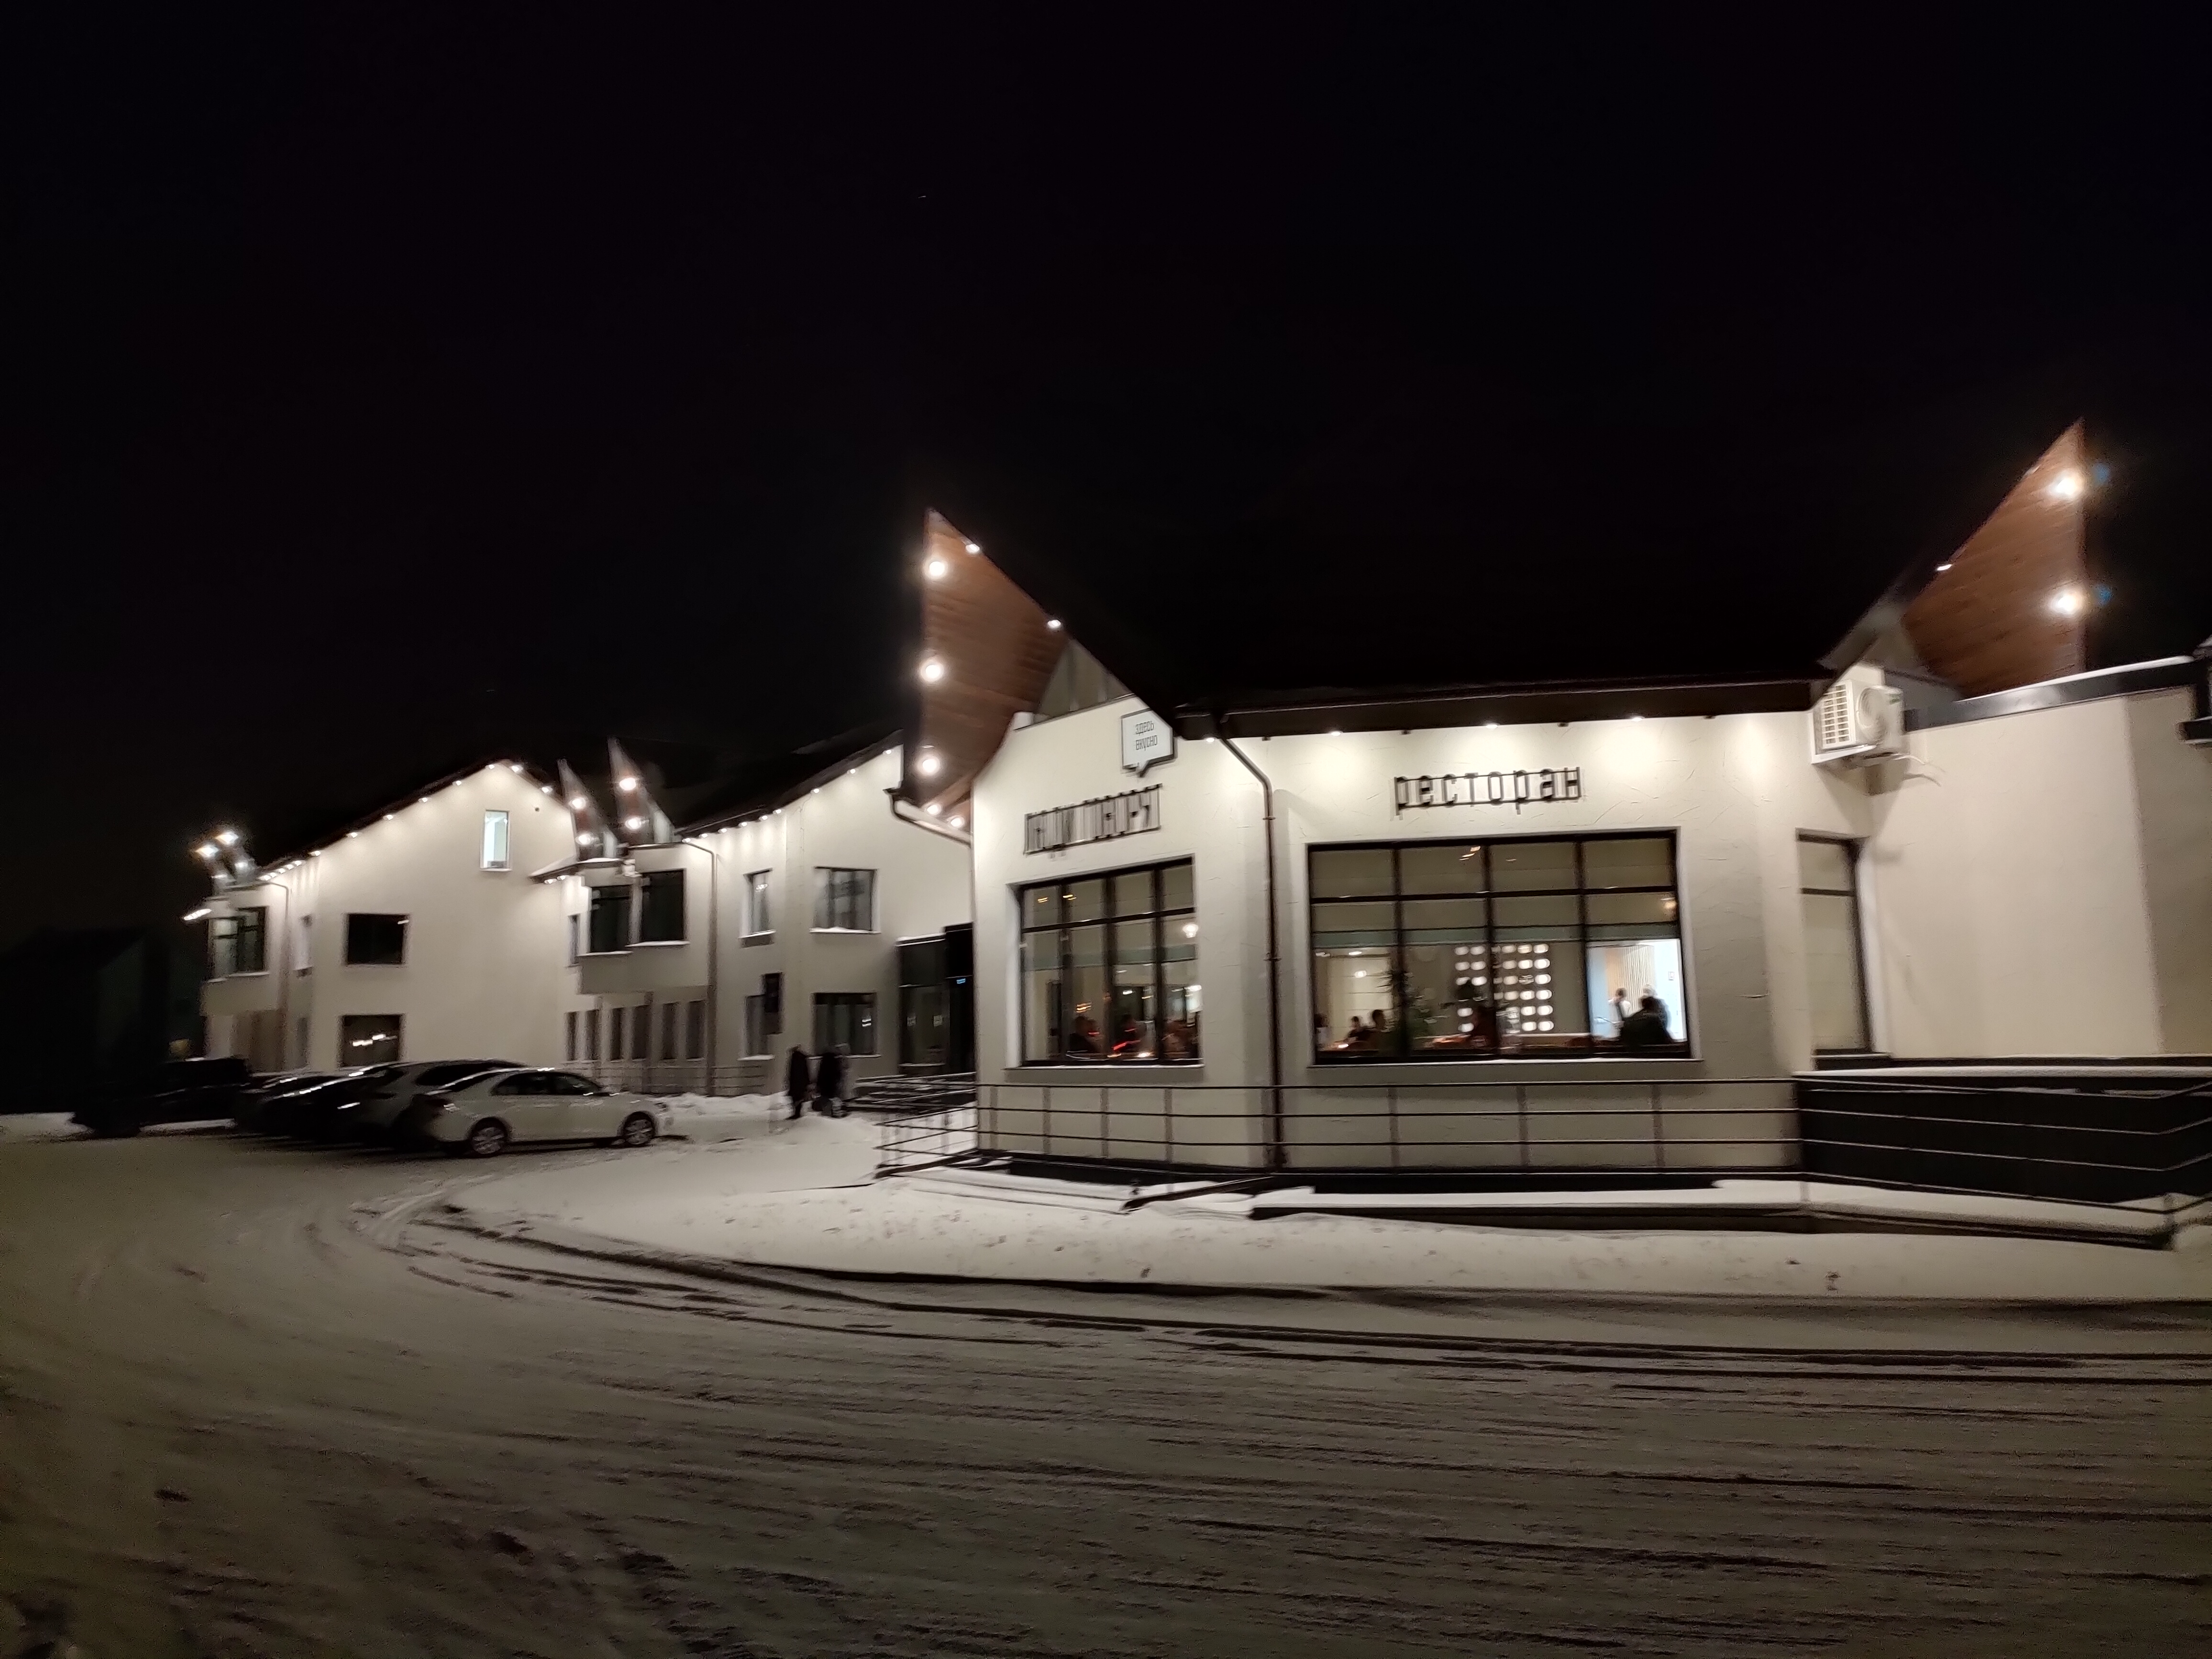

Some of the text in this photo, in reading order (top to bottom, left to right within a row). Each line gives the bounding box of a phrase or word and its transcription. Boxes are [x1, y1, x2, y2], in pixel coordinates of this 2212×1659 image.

[1135, 720, 1154, 735] здесь
[1136, 735, 1158, 751] вкусно
[1394, 767, 1582, 816] ресторан
